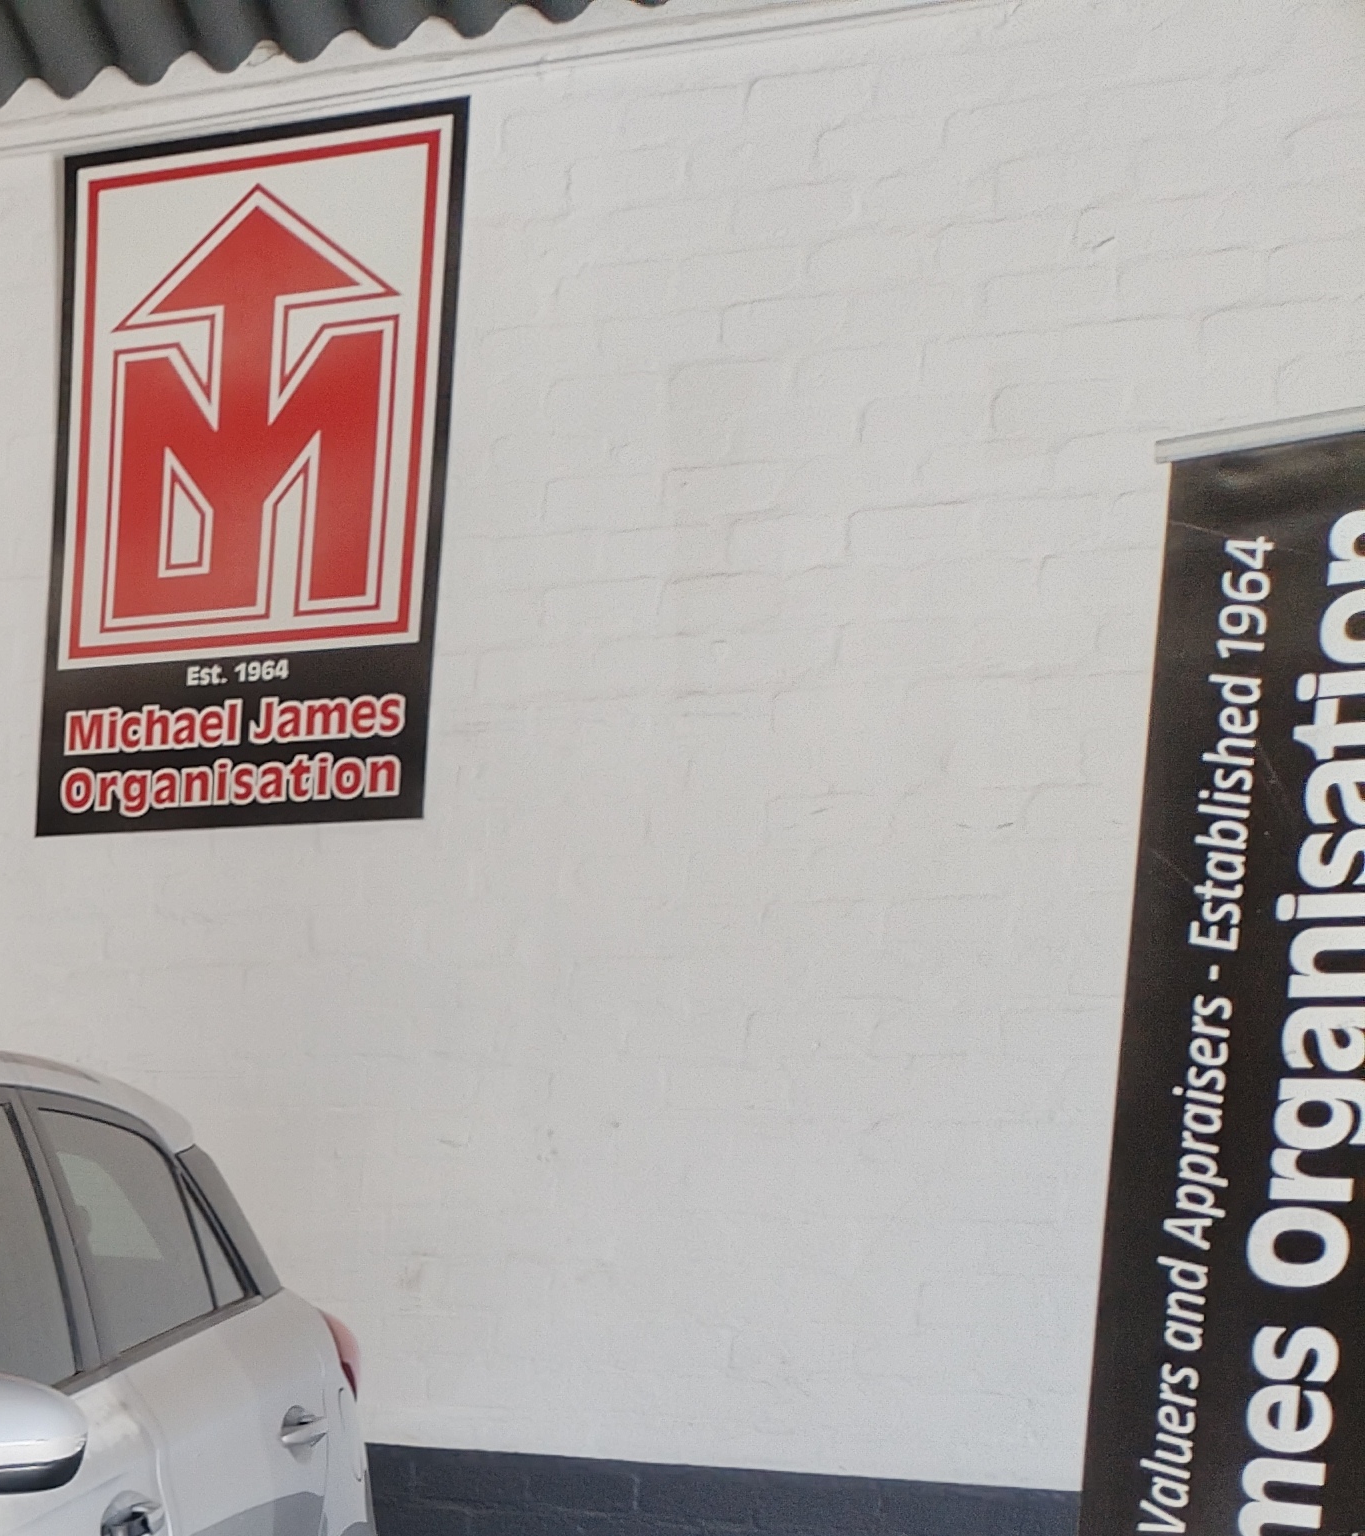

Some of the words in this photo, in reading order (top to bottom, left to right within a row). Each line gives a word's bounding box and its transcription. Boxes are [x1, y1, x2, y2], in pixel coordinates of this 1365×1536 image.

[1219, 536, 1275, 660] 1964
[64, 698, 241, 755] Michael
[249, 692, 405, 744] James
[186, 662, 229, 686] Est.
[233, 658, 290, 683] 1964
[60, 751, 401, 817] Organisation
[1189, 672, 1263, 956] Established
[1162, 994, 1234, 1253] Appraisers
[1155, 1256, 1210, 1351] and
[1136, 1361, 1200, 1534] Valuers
